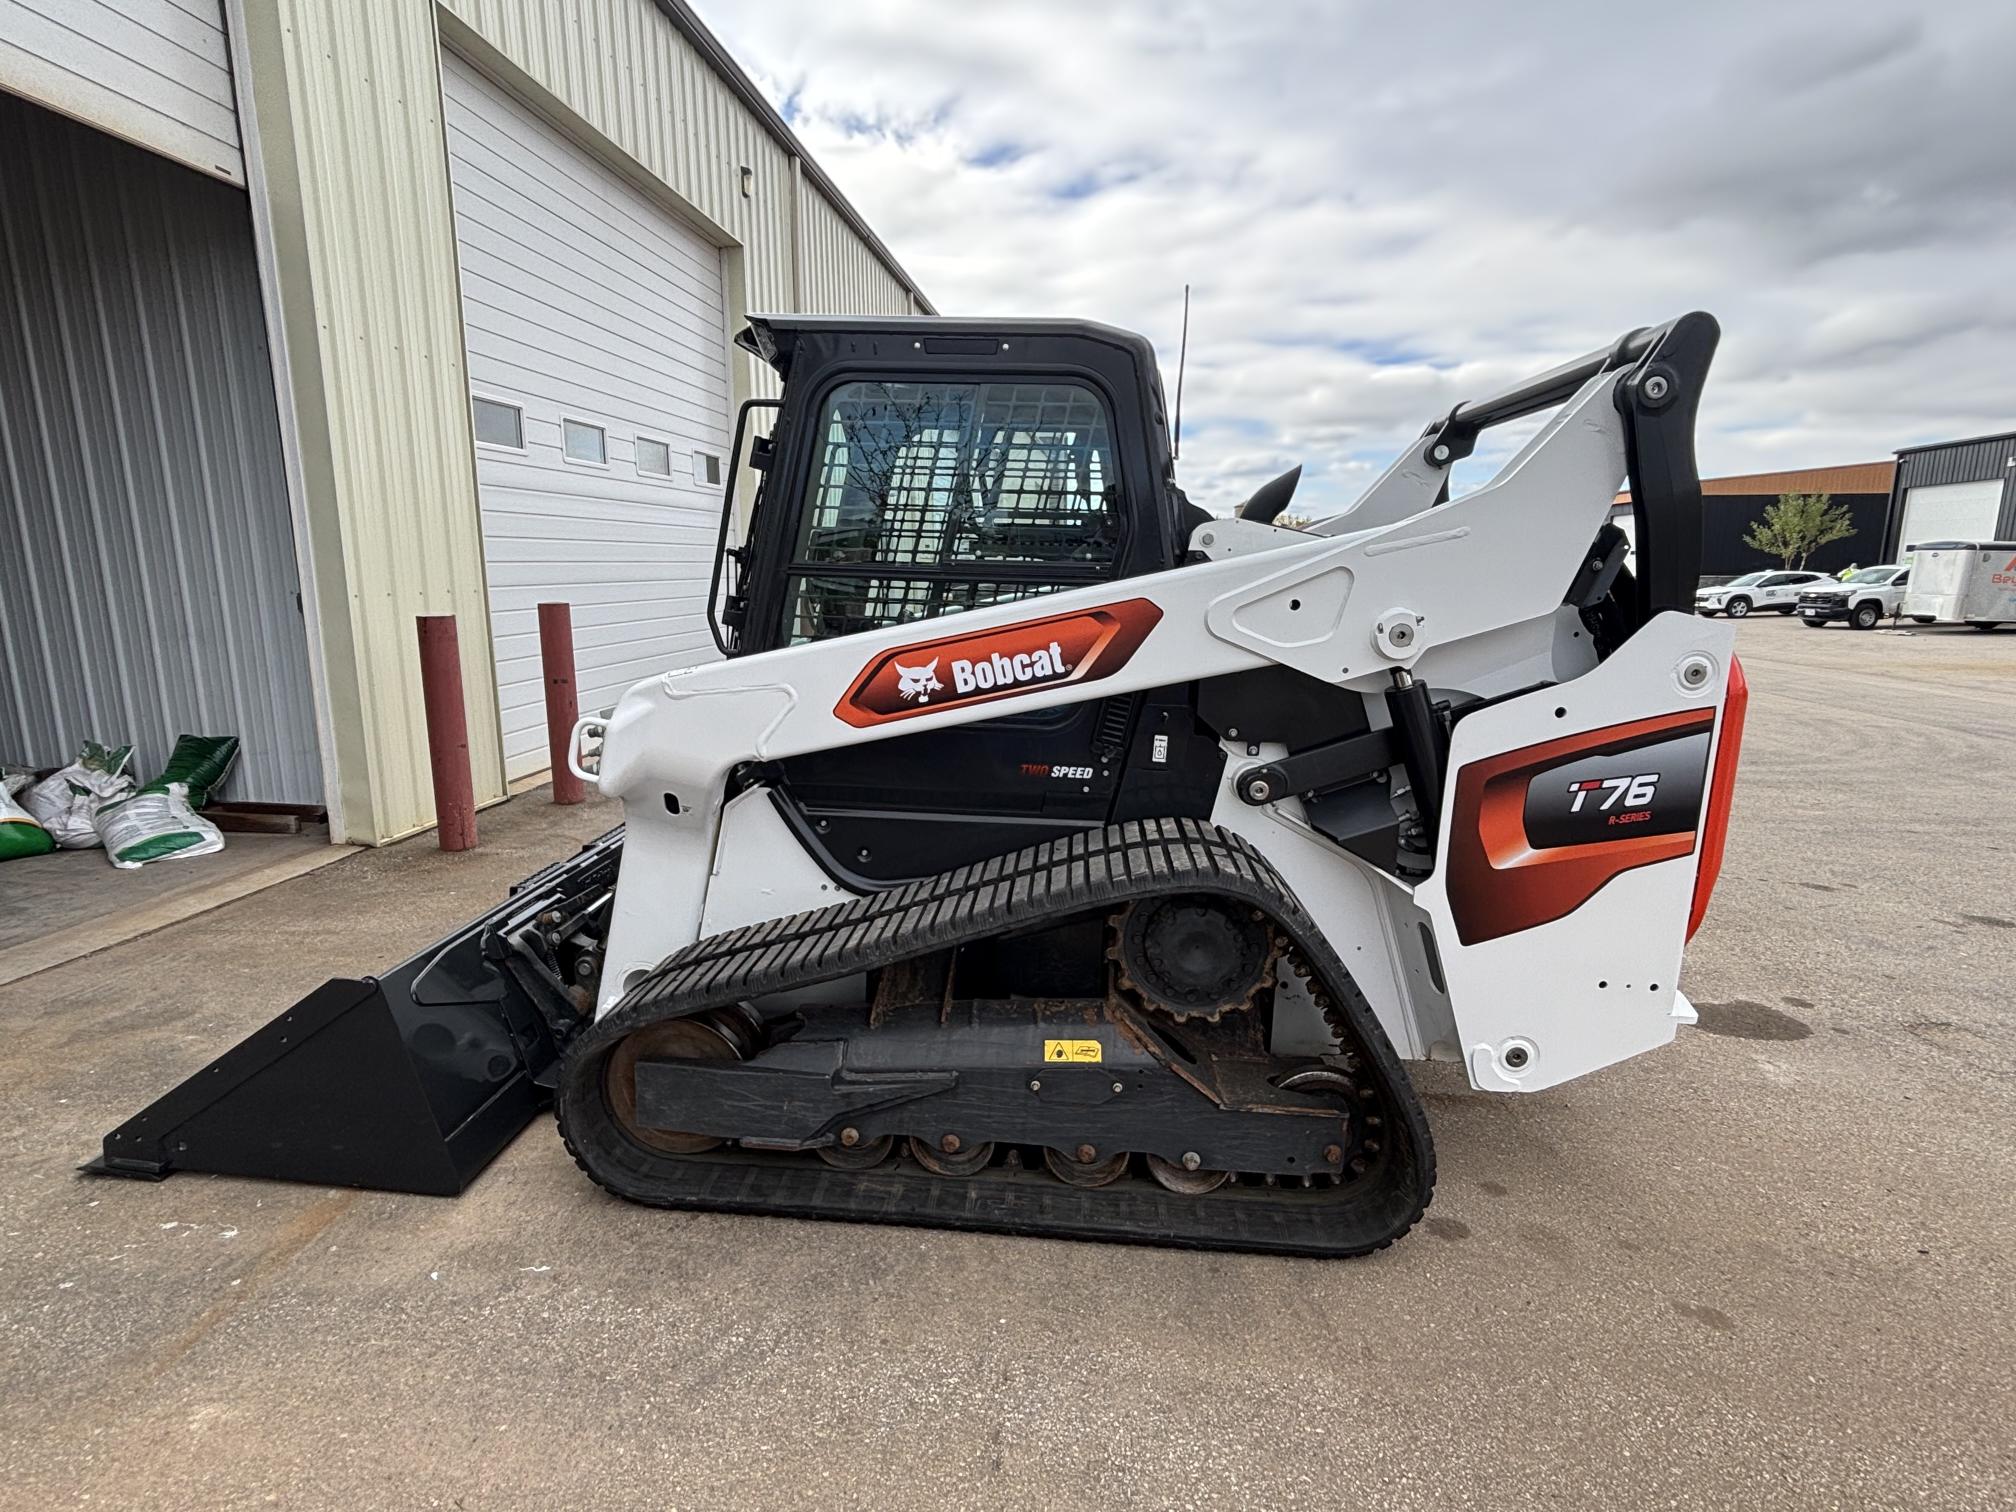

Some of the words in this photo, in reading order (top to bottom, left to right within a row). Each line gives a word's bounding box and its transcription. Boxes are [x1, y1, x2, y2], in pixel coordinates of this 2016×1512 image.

[951, 641, 1066, 694] Bobcat
[1020, 764, 1049, 776] TWO
[1050, 765, 1094, 779] SPEED
[1567, 773, 1660, 813] T76
[1608, 811, 1652, 825] R-SERIES
